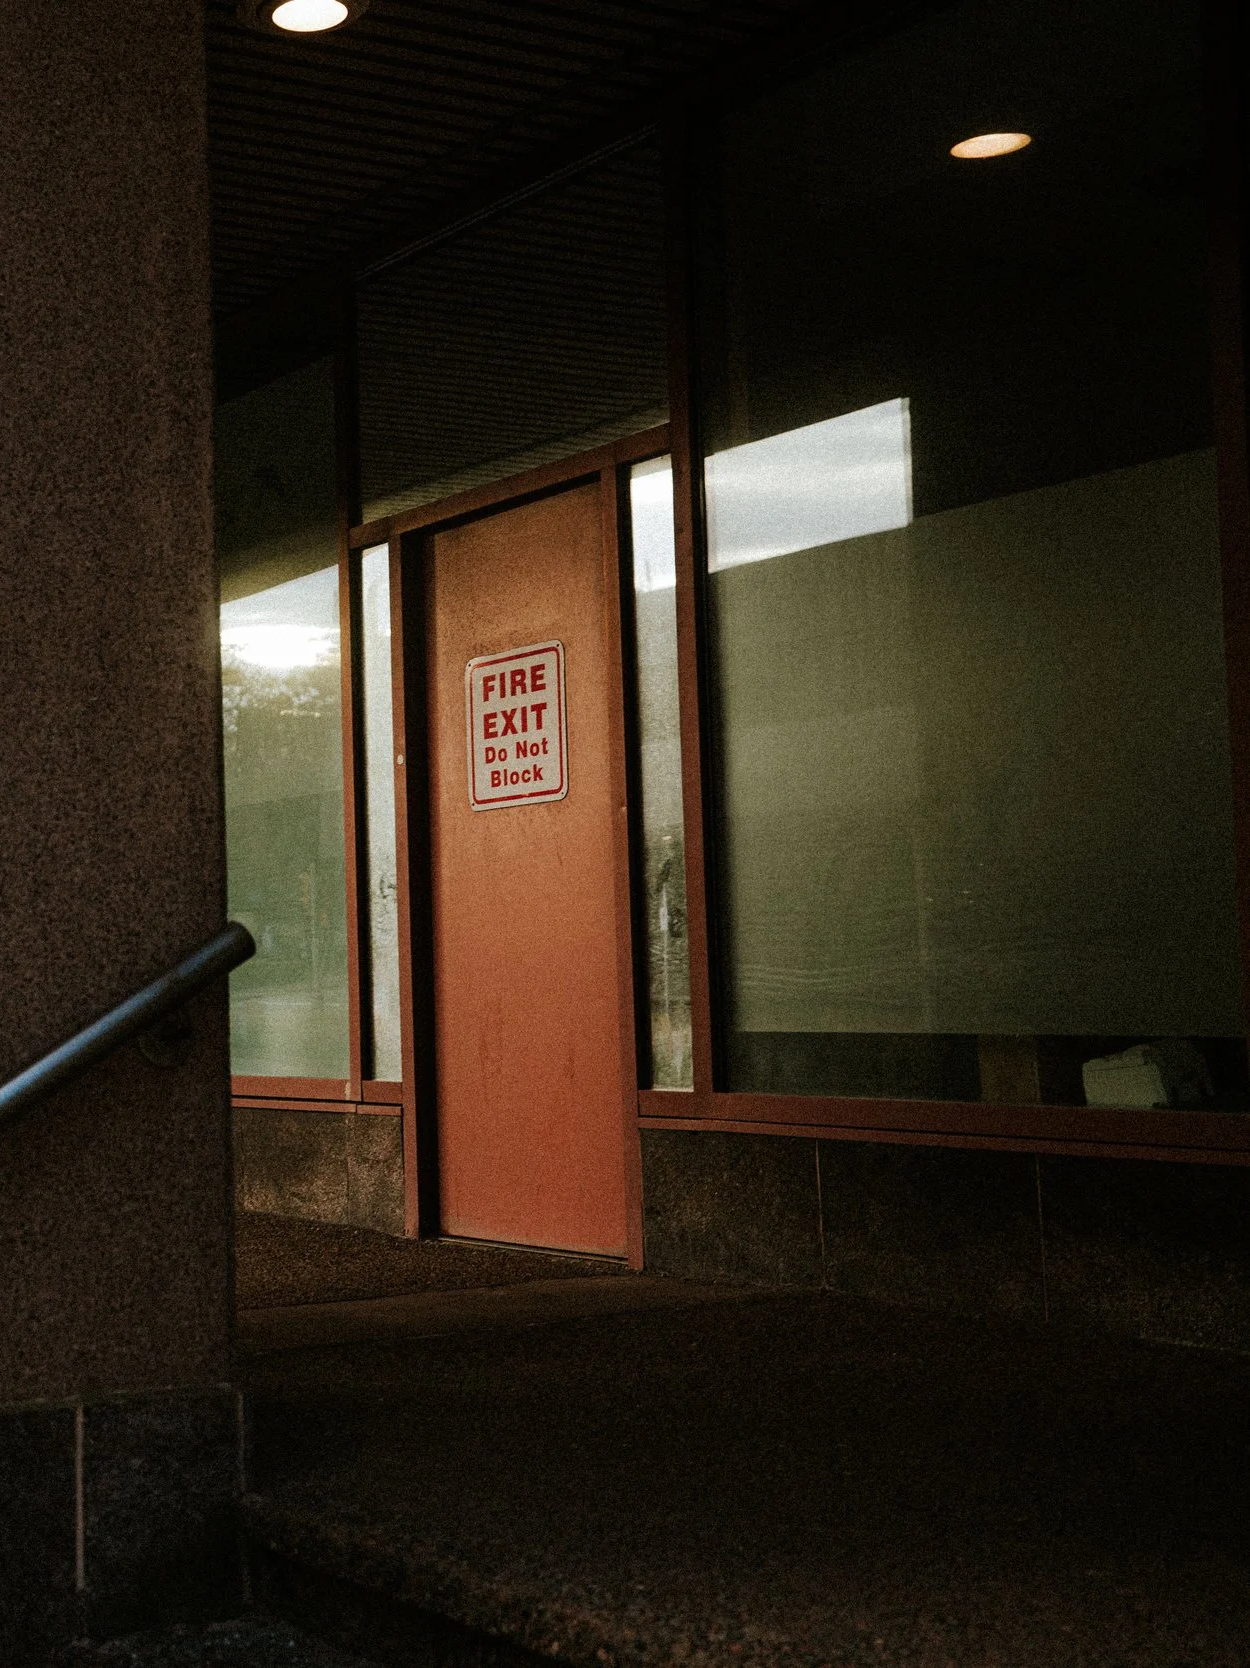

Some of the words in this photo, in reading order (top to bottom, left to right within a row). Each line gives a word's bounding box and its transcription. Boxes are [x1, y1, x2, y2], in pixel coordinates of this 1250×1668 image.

[482, 663, 547, 702] FIRE
[483, 702, 548, 740] EXIT
[485, 746, 508, 765] Do
[515, 737, 549, 759] Not
[490, 764, 544, 788] Block
